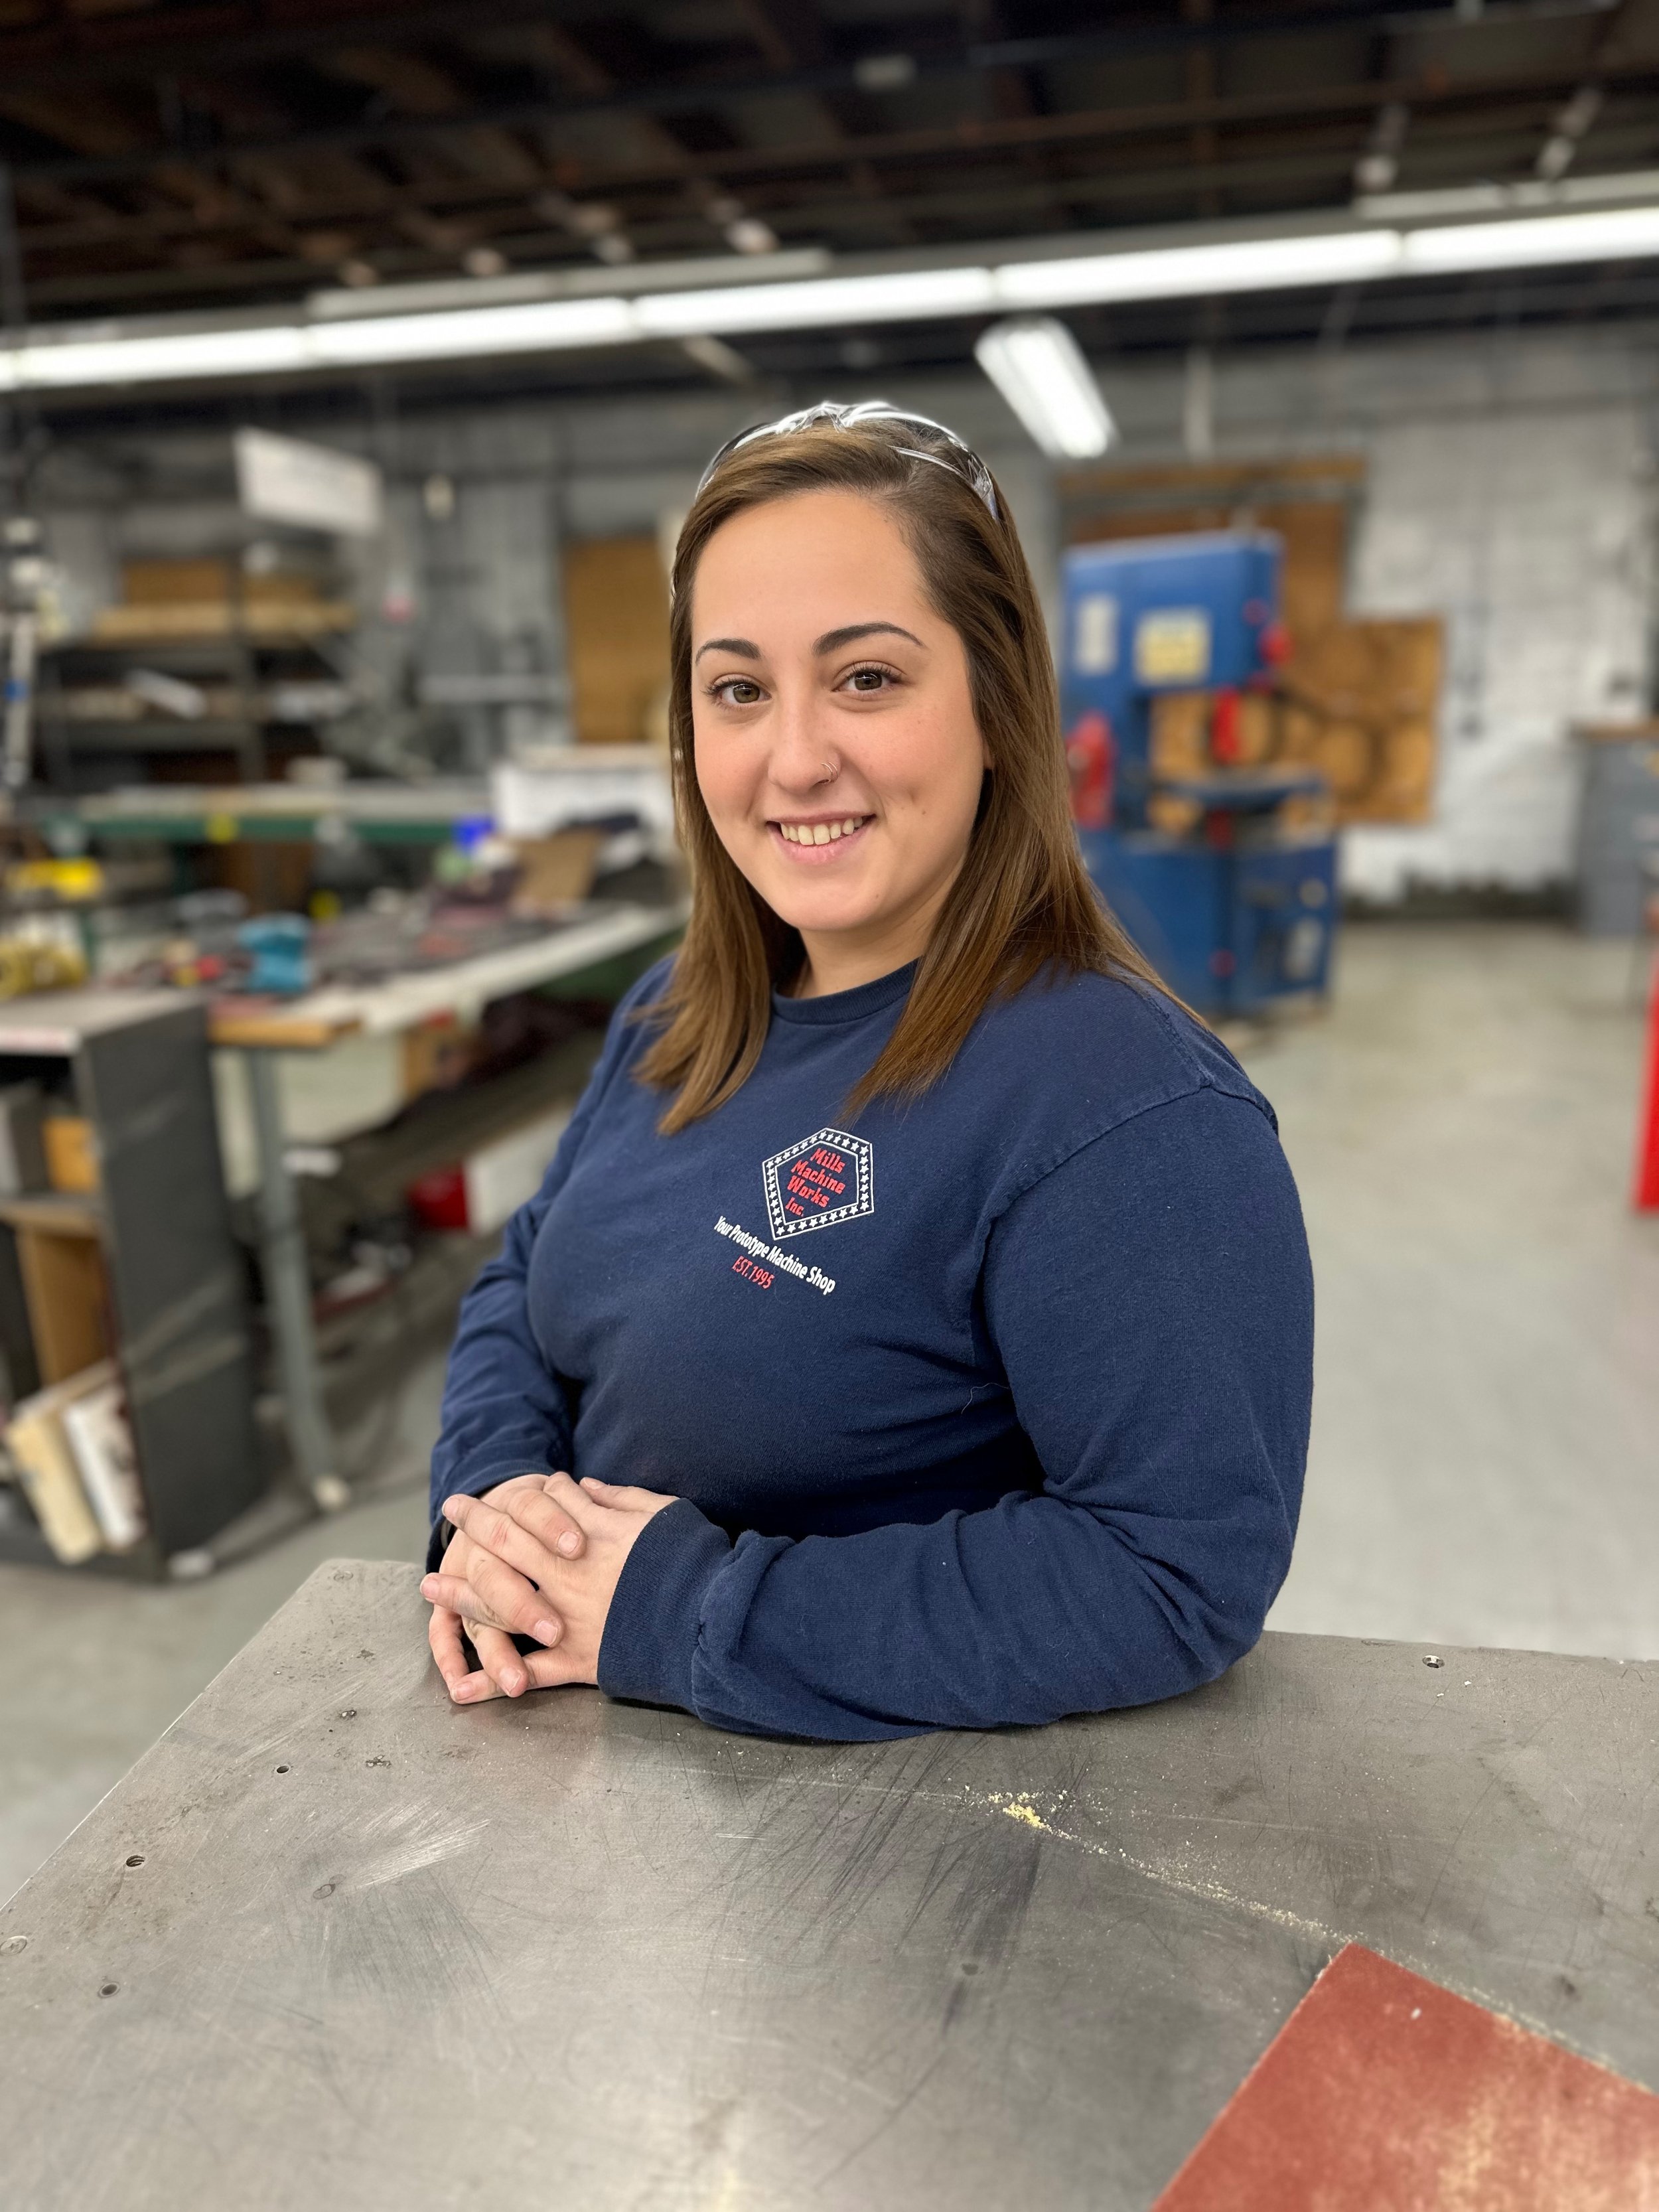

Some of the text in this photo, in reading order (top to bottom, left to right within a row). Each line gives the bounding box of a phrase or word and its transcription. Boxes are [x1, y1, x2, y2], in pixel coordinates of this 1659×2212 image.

[810, 1148, 845, 1173] Mills
[788, 1175, 830, 1207] Works
[791, 1160, 845, 1194] Machine
[786, 1197, 804, 1217] Inc.
[714, 1216, 836, 1295] Your Prototype Machine Shop
